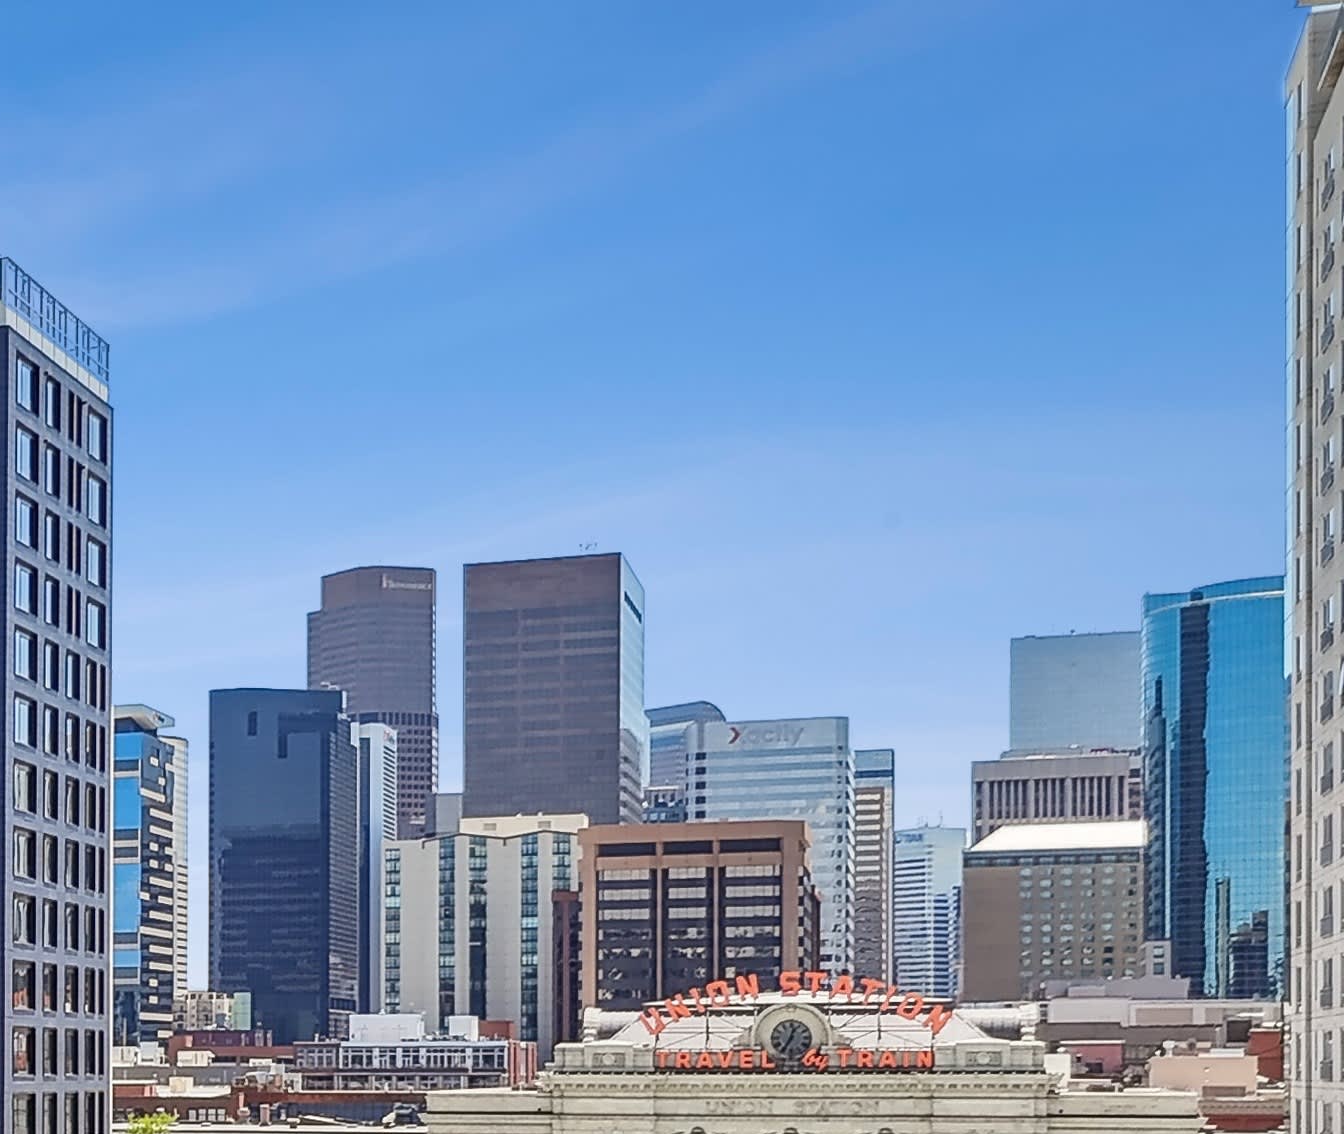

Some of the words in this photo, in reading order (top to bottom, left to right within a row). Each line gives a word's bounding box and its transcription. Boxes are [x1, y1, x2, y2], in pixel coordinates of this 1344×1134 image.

[640, 973, 759, 1035] UNION
[780, 971, 952, 1035] STATION
[655, 1050, 775, 1069] TRAVEL
[802, 1048, 829, 1071] by
[837, 1050, 935, 1069] TRAIN
